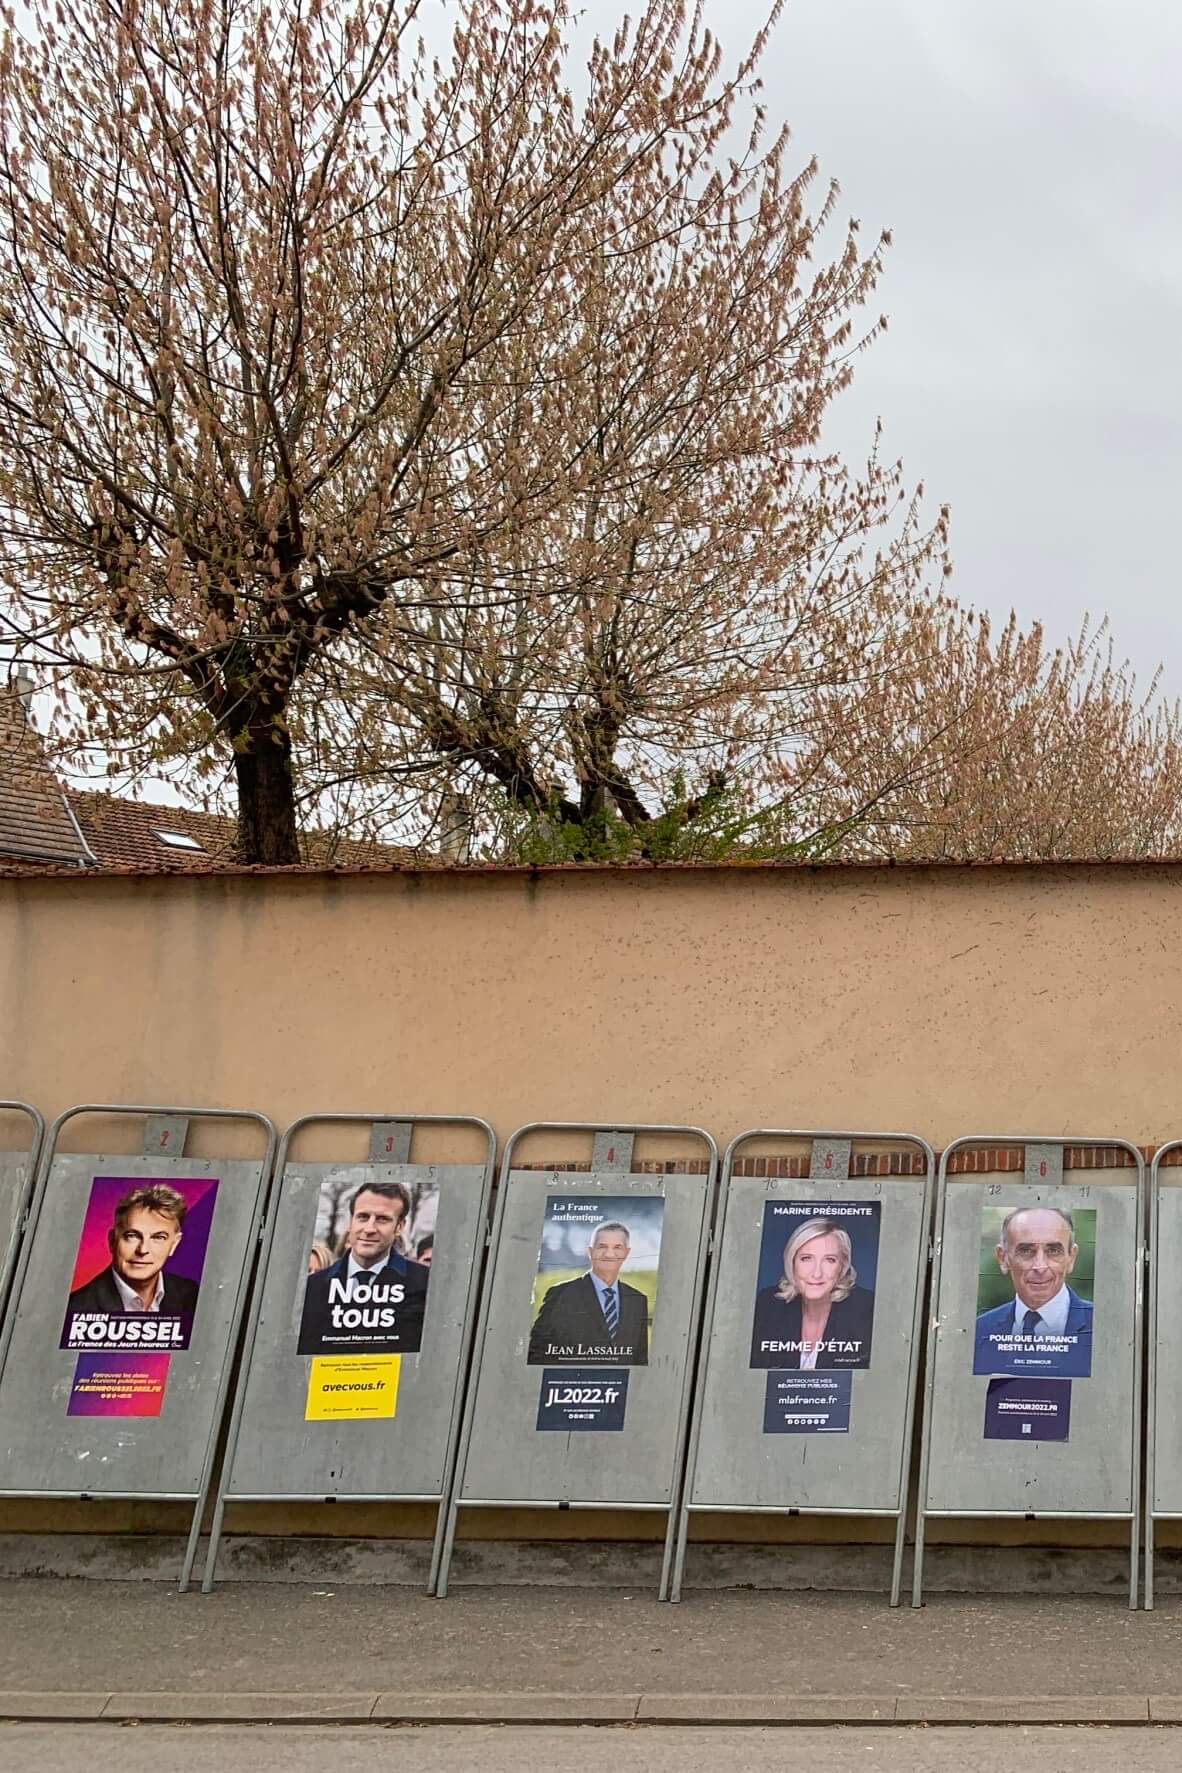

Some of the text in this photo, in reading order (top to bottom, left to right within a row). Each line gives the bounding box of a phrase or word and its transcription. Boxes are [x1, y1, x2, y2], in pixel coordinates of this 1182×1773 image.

[160, 1130, 170, 1147] 2
[385, 1137, 394, 1152] 3
[1039, 1160, 1047, 1177] 6
[553, 1203, 598, 1211] La France
[774, 1206, 872, 1216] MARINE PRÉSIDENTE
[552, 1213, 604, 1223] authentique
[327, 1278, 405, 1304] Nous
[73, 1313, 110, 1321] FABIEN
[331, 1304, 396, 1328] tous
[69, 1321, 184, 1341] ROUSSEL
[761, 1337, 862, 1352] FEMME D'ÉTAT
[1033, 1335, 1044, 1343] LA
[1024, 1344, 1035, 1352] LA
[322, 1380, 386, 1392] avecvous.fr
[545, 1388, 620, 1407] JL2022.fr
[778, 1395, 838, 1404] mlafrance.fr
[998, 1403, 1058, 1411] ZEMMOUR2022.FR
